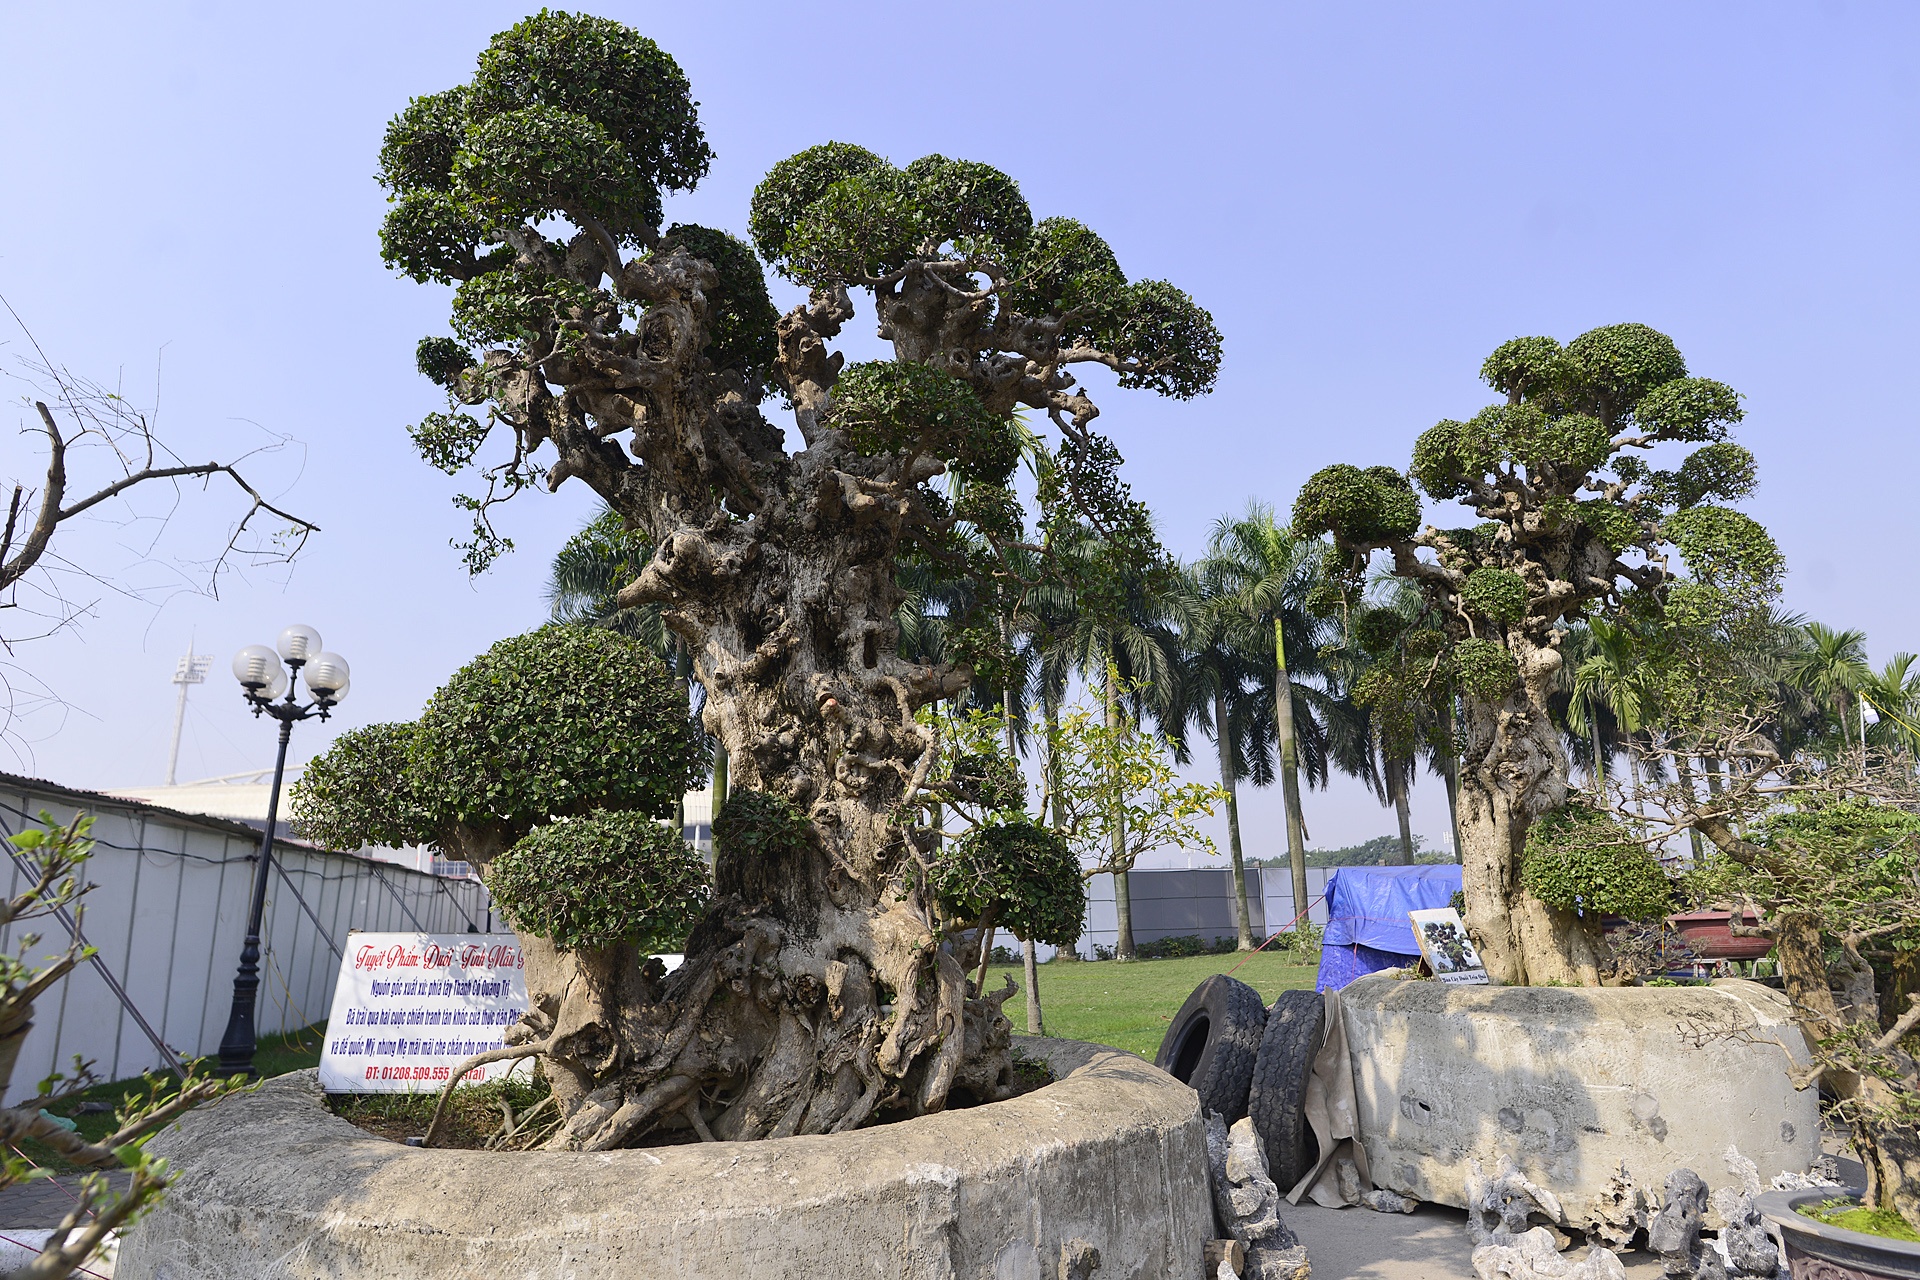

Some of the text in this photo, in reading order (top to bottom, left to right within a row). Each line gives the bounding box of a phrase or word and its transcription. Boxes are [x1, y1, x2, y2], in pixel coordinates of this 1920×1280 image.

[355, 944, 386, 972] Tuyệt
[461, 944, 486, 970] Tình
[390, 976, 403, 998] gốc
[442, 979, 453, 998] tây
[453, 979, 472, 996] Thành
[482, 977, 501, 998] Quảng
[501, 979, 511, 1000] Trị
[367, 1011, 380, 1027] qua
[379, 1008, 391, 1025] hai
[390, 1007, 407, 1029] cuộc
[406, 1005, 425, 1025] chiến
[424, 1008, 441, 1025] tranh
[452, 1006, 468, 1025] khốc
[468, 1006, 481, 1025] của
[330, 1037, 339, 1055] và
[348, 1035, 365, 1057] quốc
[396, 1038, 408, 1059] Mẹ
[407, 1038, 421, 1055] mãi
[420, 1038, 434, 1055] mãi
[433, 1038, 446, 1055] che
[462, 1038, 475, 1055] cho
[365, 1066, 380, 1080] ĐT:
[381, 1066, 450, 1080] 01208.509.555
